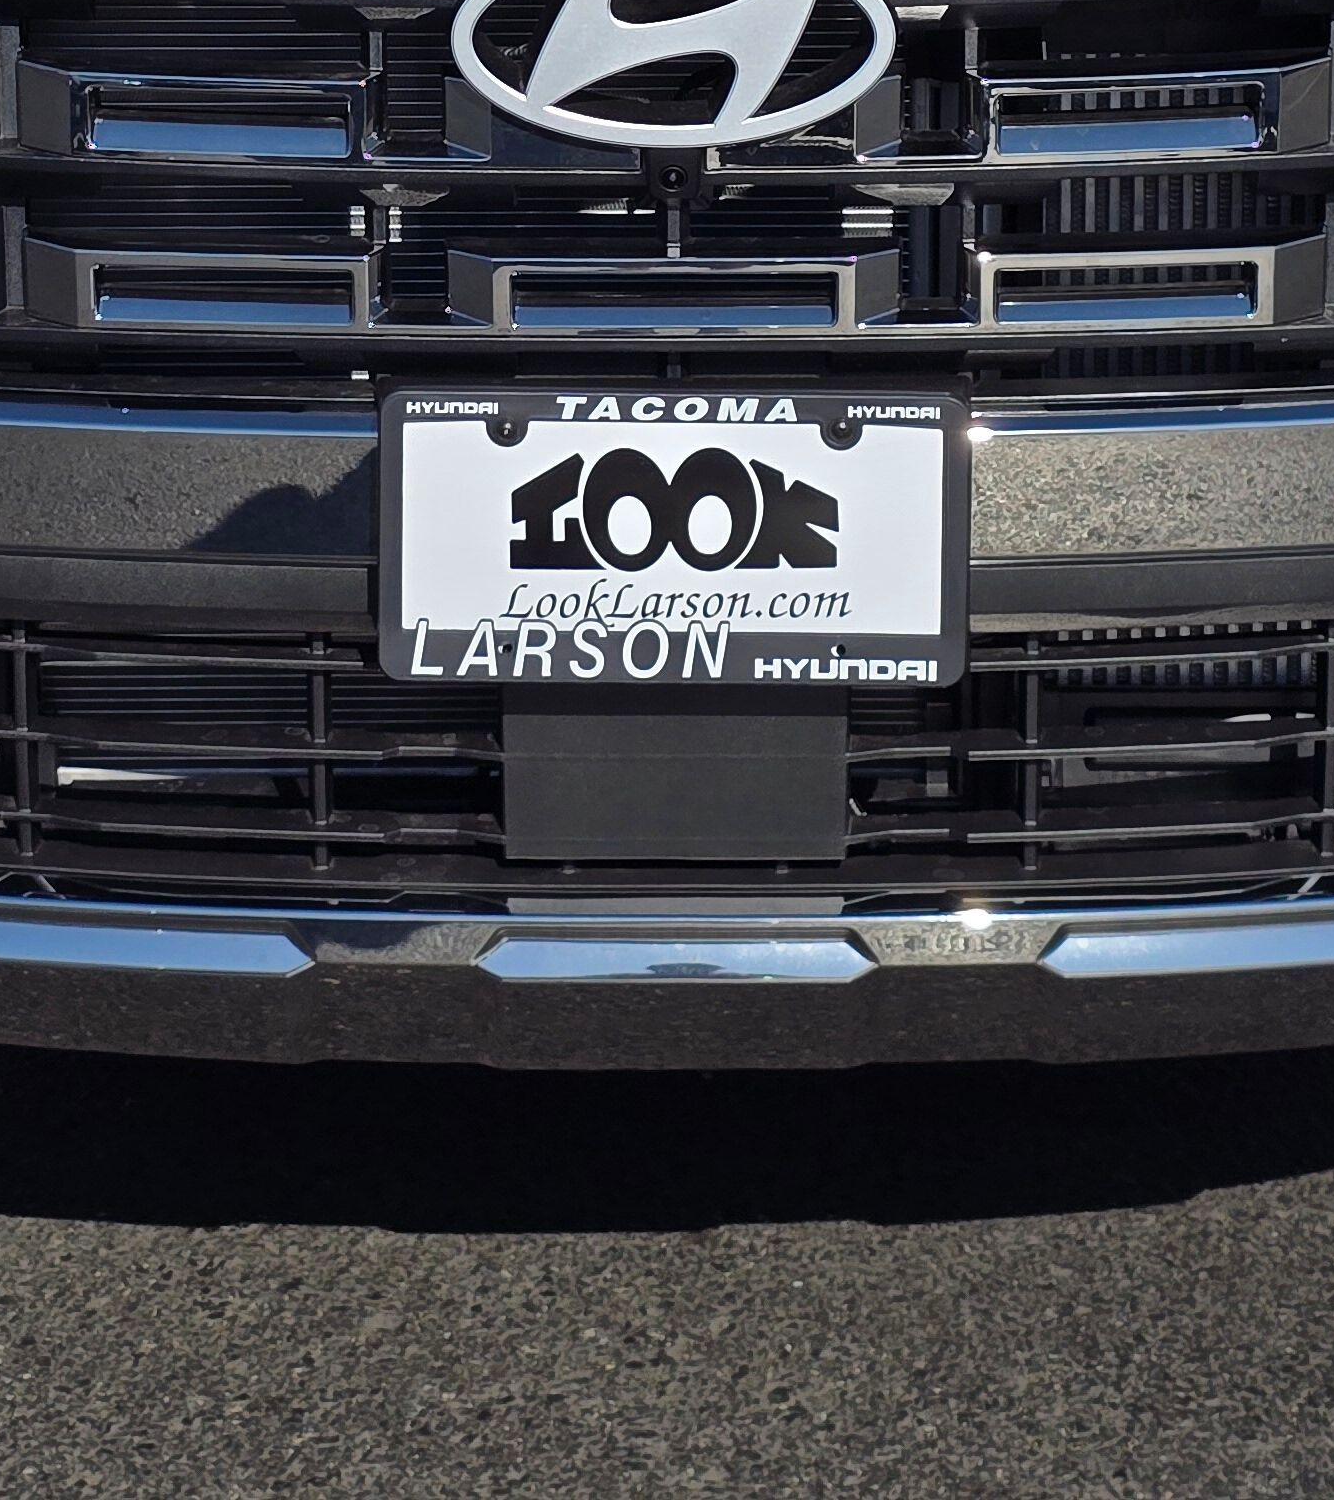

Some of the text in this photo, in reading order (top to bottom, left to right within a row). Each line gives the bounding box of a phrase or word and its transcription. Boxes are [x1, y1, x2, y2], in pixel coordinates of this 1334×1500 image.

[405, 401, 499, 415] HYUNDAI
[555, 395, 798, 422] TACOMA
[847, 405, 941, 420] HYUNDAI
[509, 447, 840, 572] LOOK
[498, 578, 853, 628] LookLarson.com
[410, 619, 938, 682] LARSON HYUNDAI
